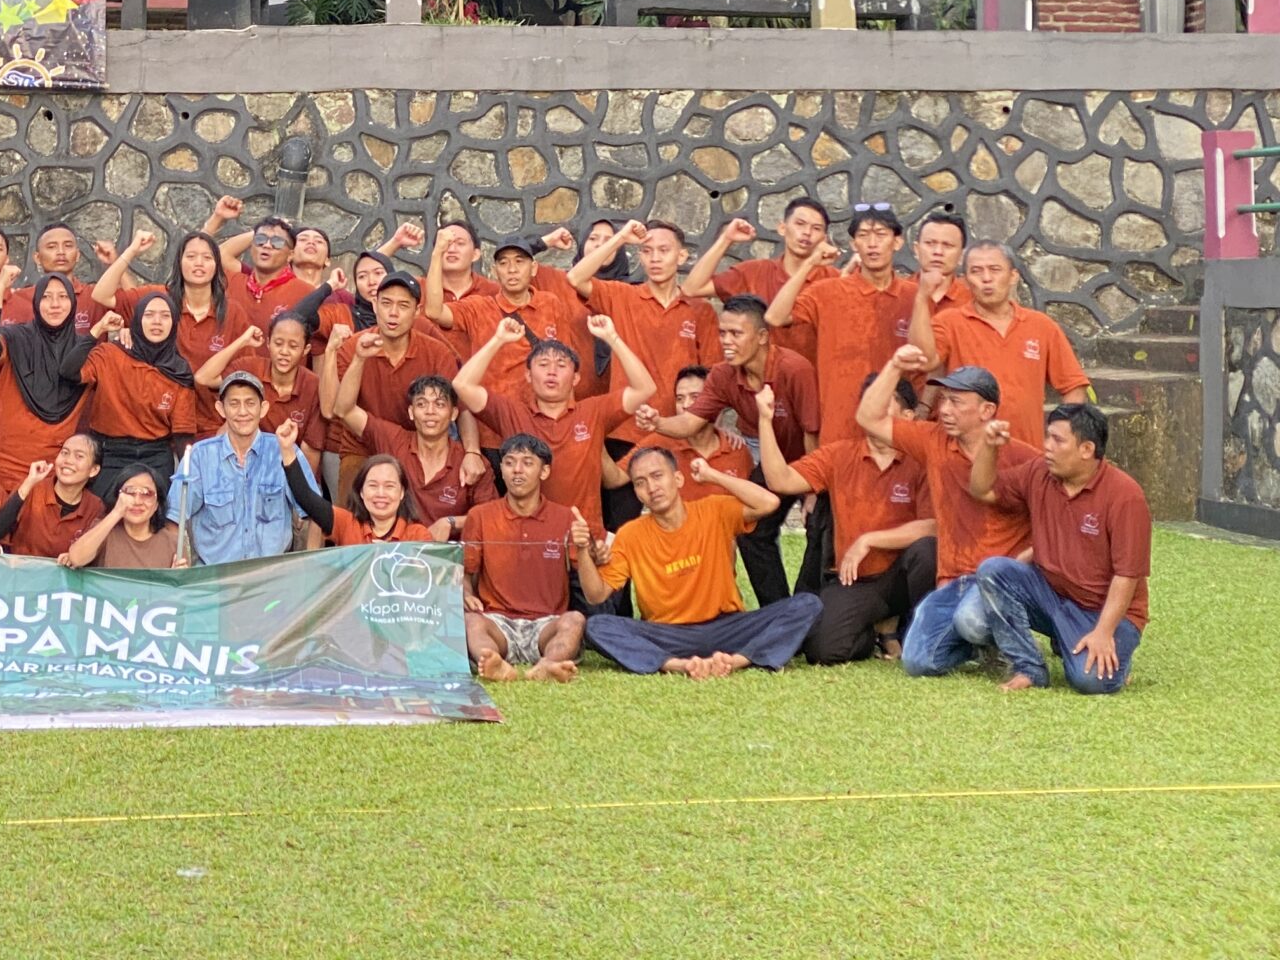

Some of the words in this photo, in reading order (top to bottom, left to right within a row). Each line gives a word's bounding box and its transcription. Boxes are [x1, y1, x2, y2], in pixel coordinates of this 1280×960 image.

[360, 598, 400, 617] Klapa
[403, 600, 443, 617] Manis
[84, 628, 261, 677] MANIS
[47, 661, 212, 686] KEMAYORAN
